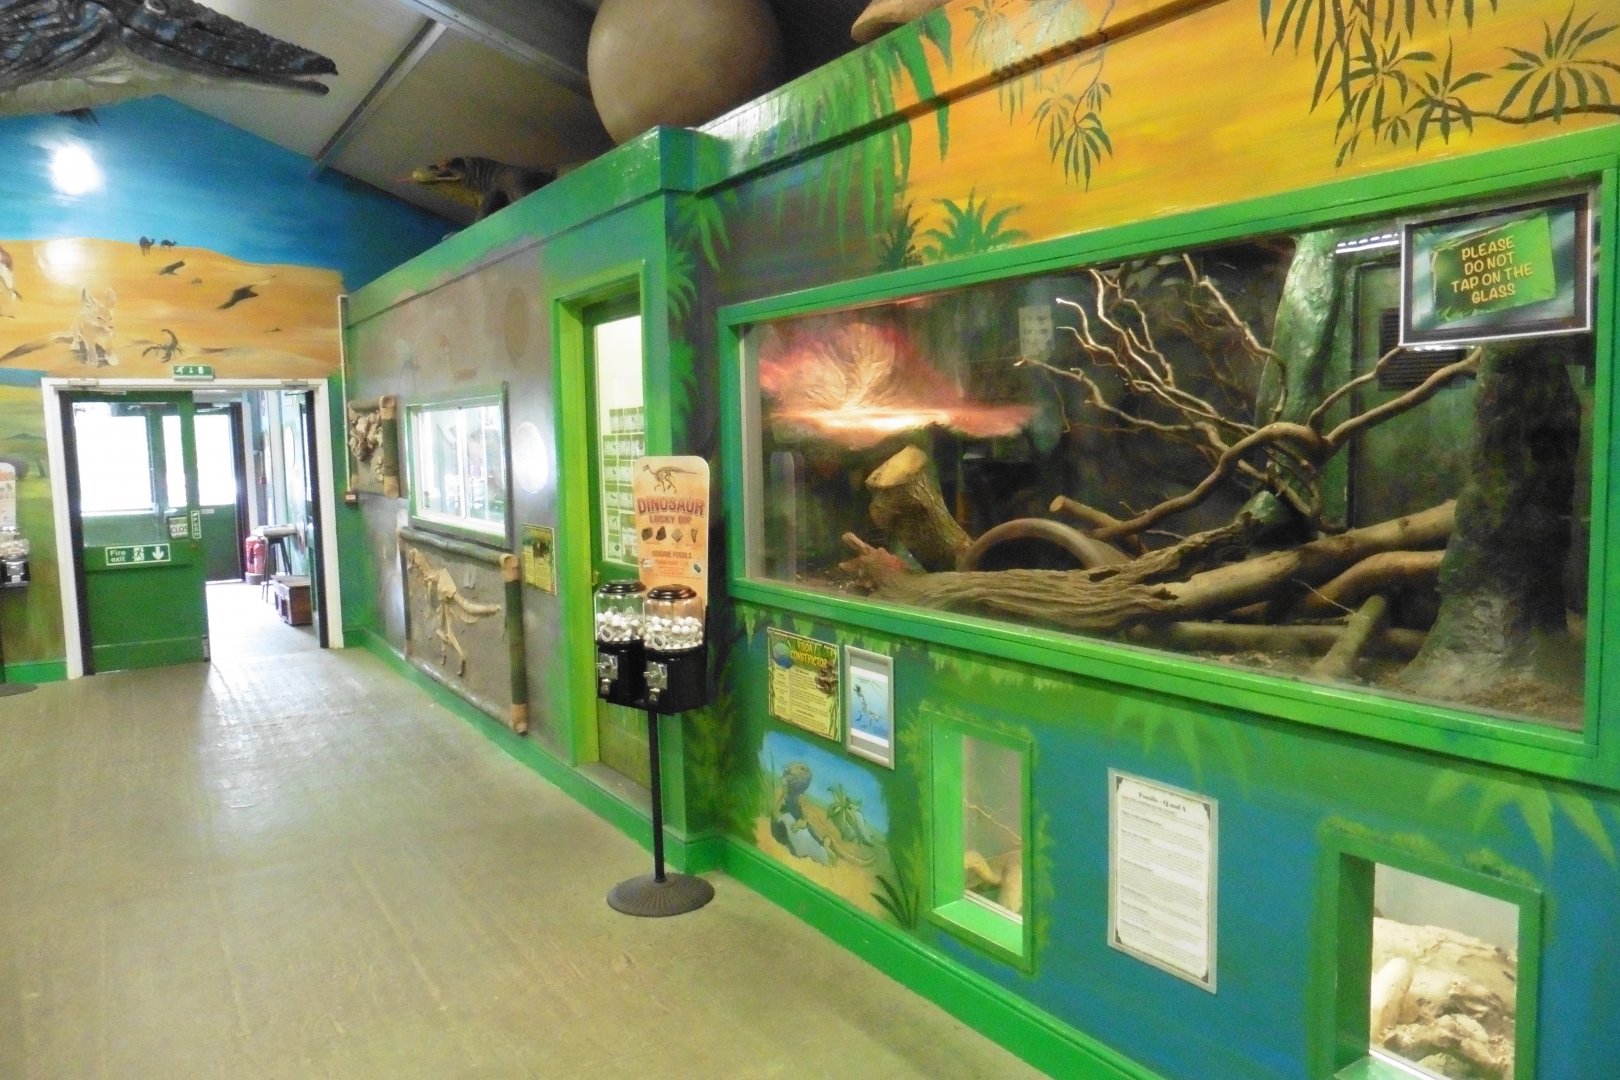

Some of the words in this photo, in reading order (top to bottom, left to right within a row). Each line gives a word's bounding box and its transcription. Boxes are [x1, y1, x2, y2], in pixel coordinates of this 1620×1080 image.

[1461, 235, 1516, 261] PLEASE
[1464, 261, 1485, 275] DO
[1487, 252, 1515, 270] NOT
[1451, 277, 1479, 293] TAP
[1481, 271, 1501, 286] ON
[1504, 263, 1533, 281] THE
[1471, 284, 1516, 304] GLASS
[637, 497, 704, 515] DINOSAUR
